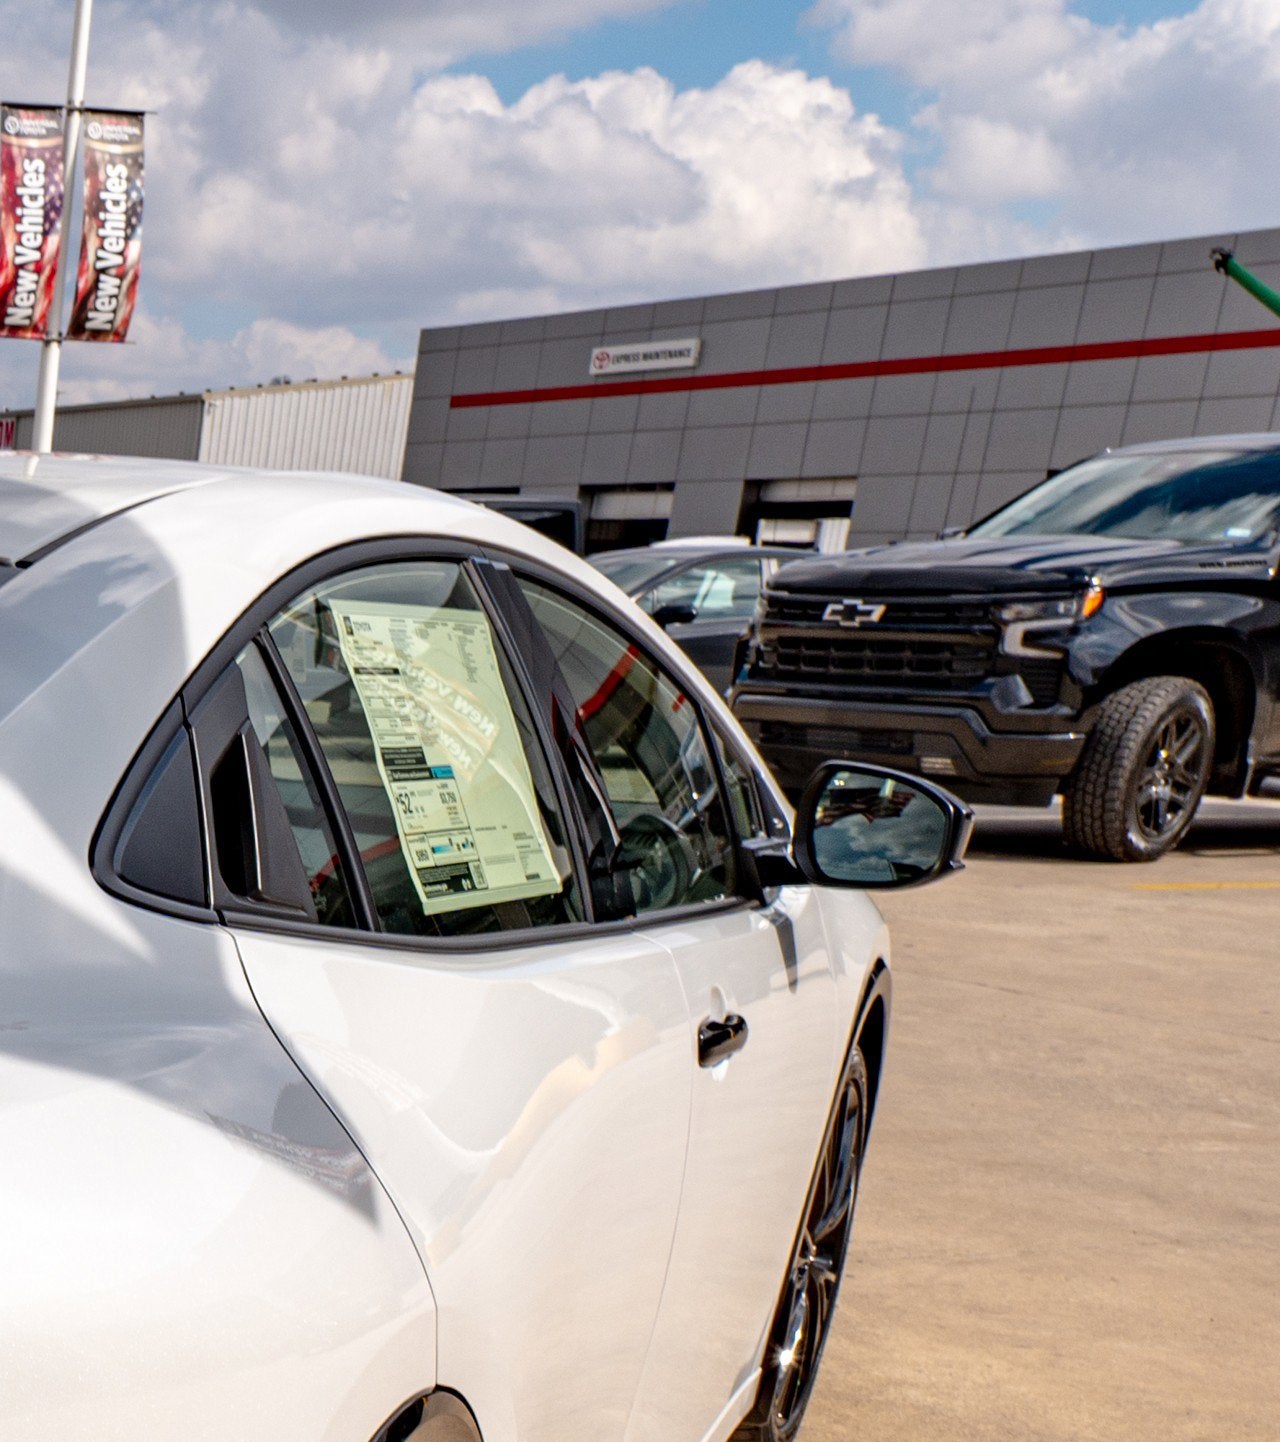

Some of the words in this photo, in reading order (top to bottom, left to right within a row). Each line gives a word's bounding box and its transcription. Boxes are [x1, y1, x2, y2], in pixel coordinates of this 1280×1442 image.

[13, 158, 46, 266] Vehicles
[95, 163, 128, 271] Vehicles
[3, 272, 39, 328] New
[85, 274, 122, 331] New
